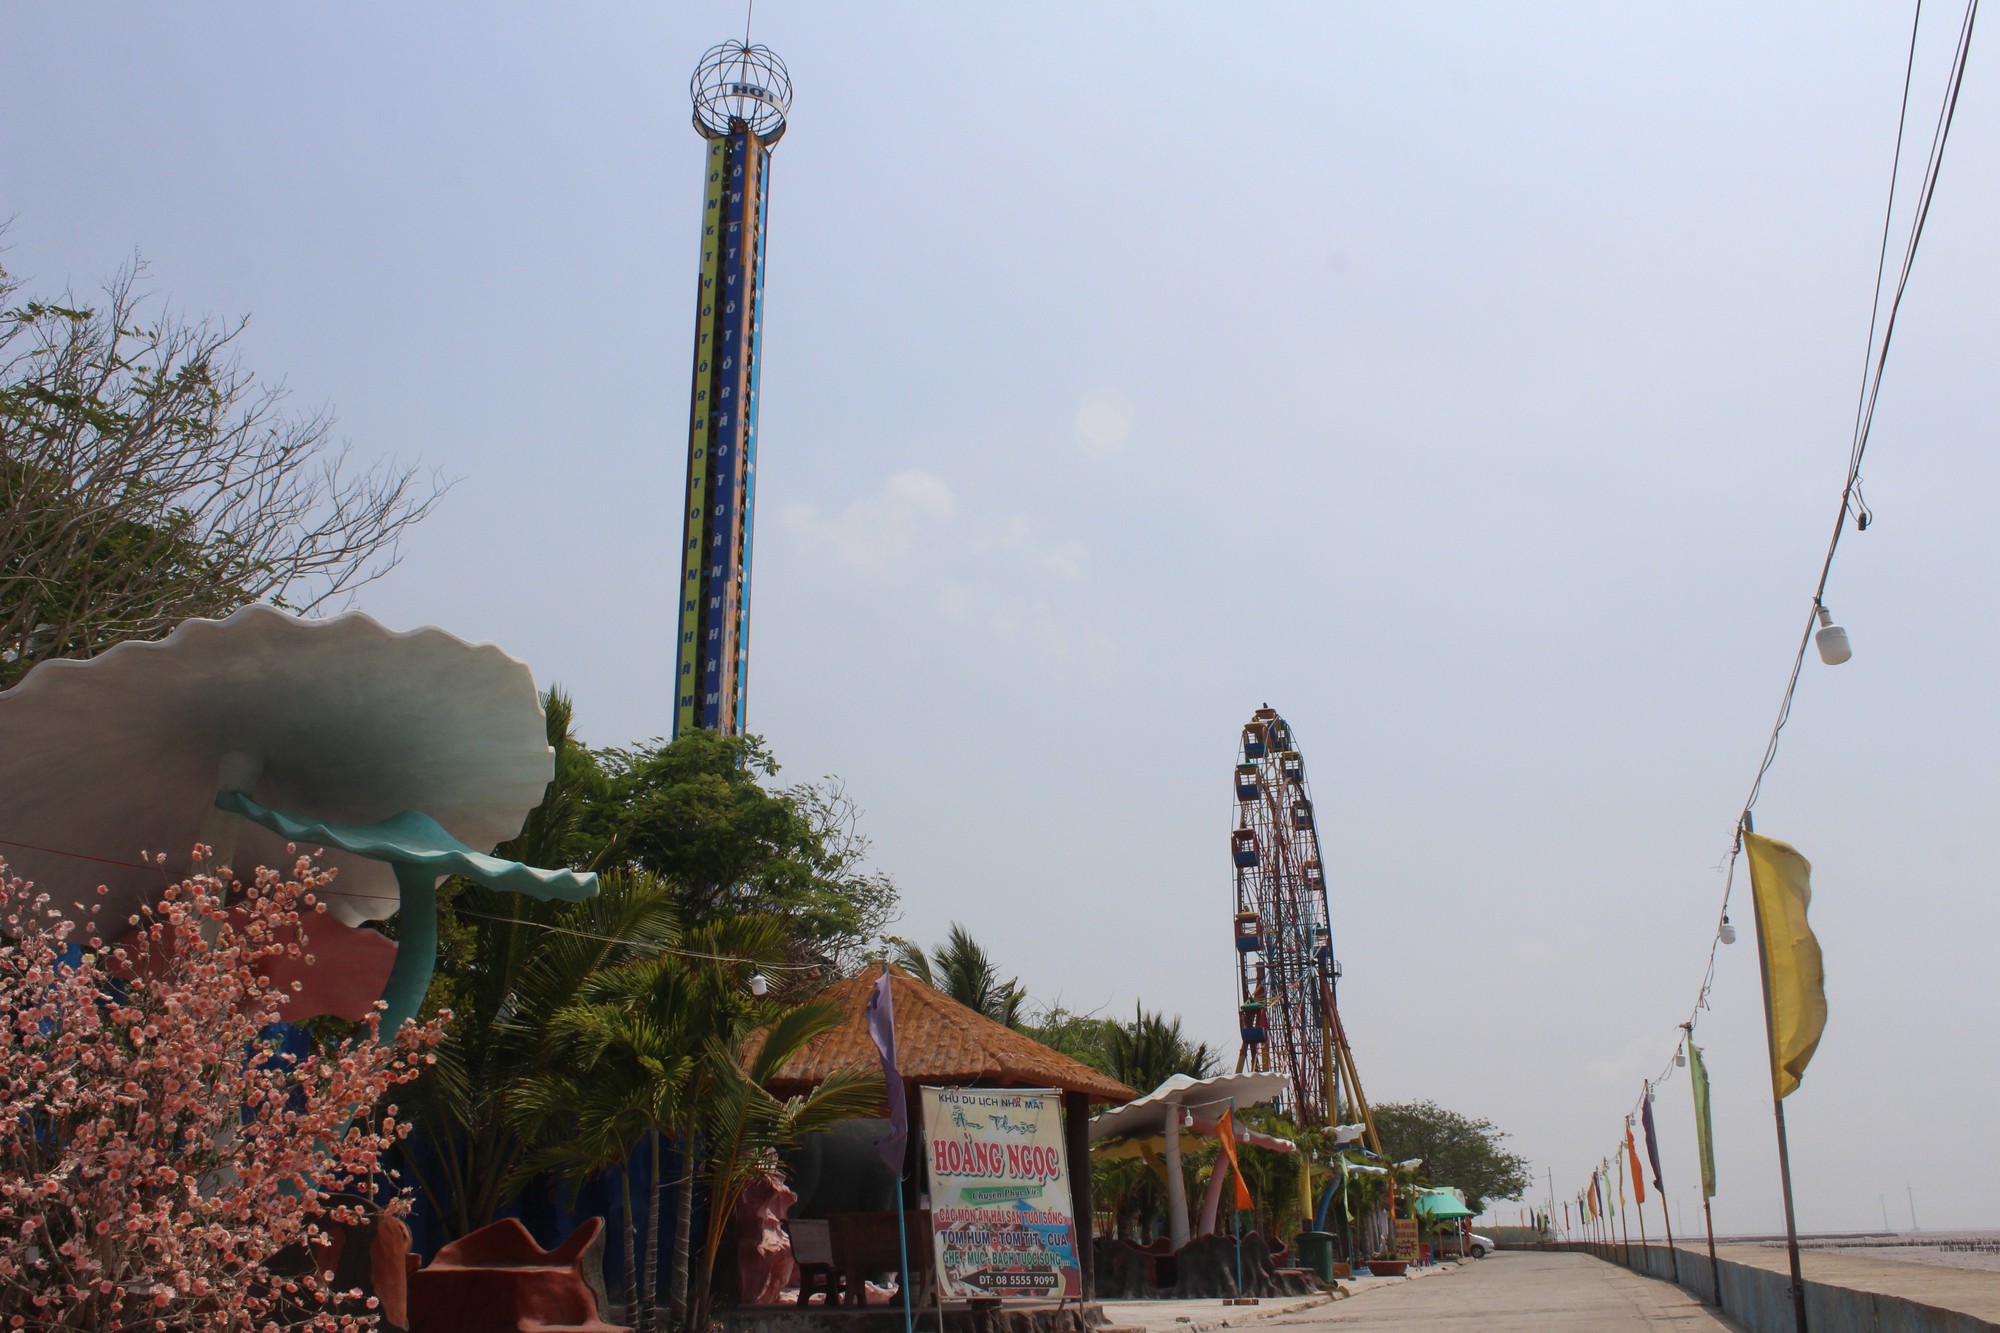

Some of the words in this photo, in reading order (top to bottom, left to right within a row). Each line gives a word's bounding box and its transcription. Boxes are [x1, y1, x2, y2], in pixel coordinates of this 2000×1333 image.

[938, 1093, 959, 1104] KHU
[962, 1095, 976, 1105] DU
[933, 1131, 1002, 1176] HOÀNG
[1006, 1143, 1058, 1183] NGỌC
[971, 1190, 1002, 1201] Chuyên
[939, 1205, 957, 1223] CÁC
[941, 1228, 964, 1245] TÔM
[998, 1229, 1021, 1246] TÔM
[1047, 1233, 1068, 1247] CUA
[942, 1251, 961, 1268] GHẸ
[979, 1275, 994, 1285] ĐT:
[995, 1275, 1007, 1285] 08
[1010, 1275, 1031, 1285] 5555
[1034, 1275, 1055, 1285] 9099
